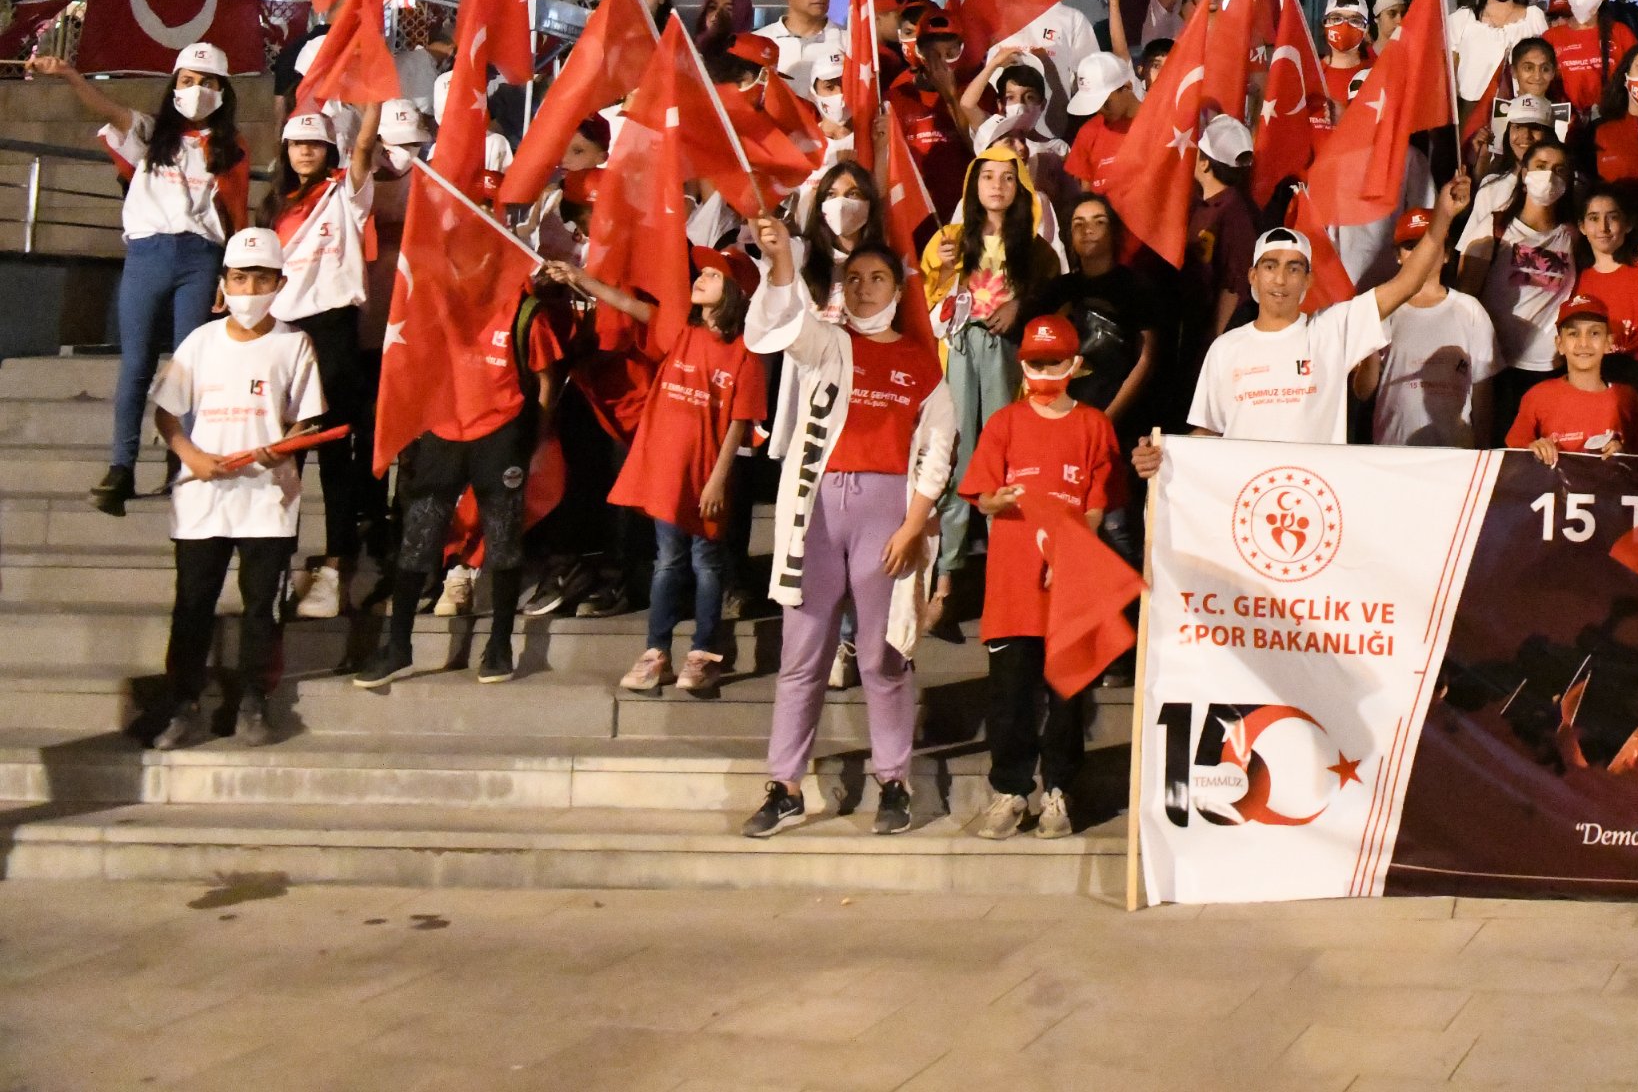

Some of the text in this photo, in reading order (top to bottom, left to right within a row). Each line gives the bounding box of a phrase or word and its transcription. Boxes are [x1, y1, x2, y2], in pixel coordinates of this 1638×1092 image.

[1521, 99, 1532, 107] 15
[245, 238, 257, 248] 15
[1296, 359, 1312, 376] 15
[251, 379, 265, 396] 15
[852, 388, 869, 398] MUZ
[1245, 388, 1279, 400] TEMMUZ
[1530, 492, 1597, 543] 15
[1181, 592, 1395, 627] T.C. GENÇLİK VE
[1178, 624, 1394, 656] SPOR BAKANLIĞI
[1157, 702, 1272, 828] 15
[1194, 776, 1244, 789] TEMMUZ
